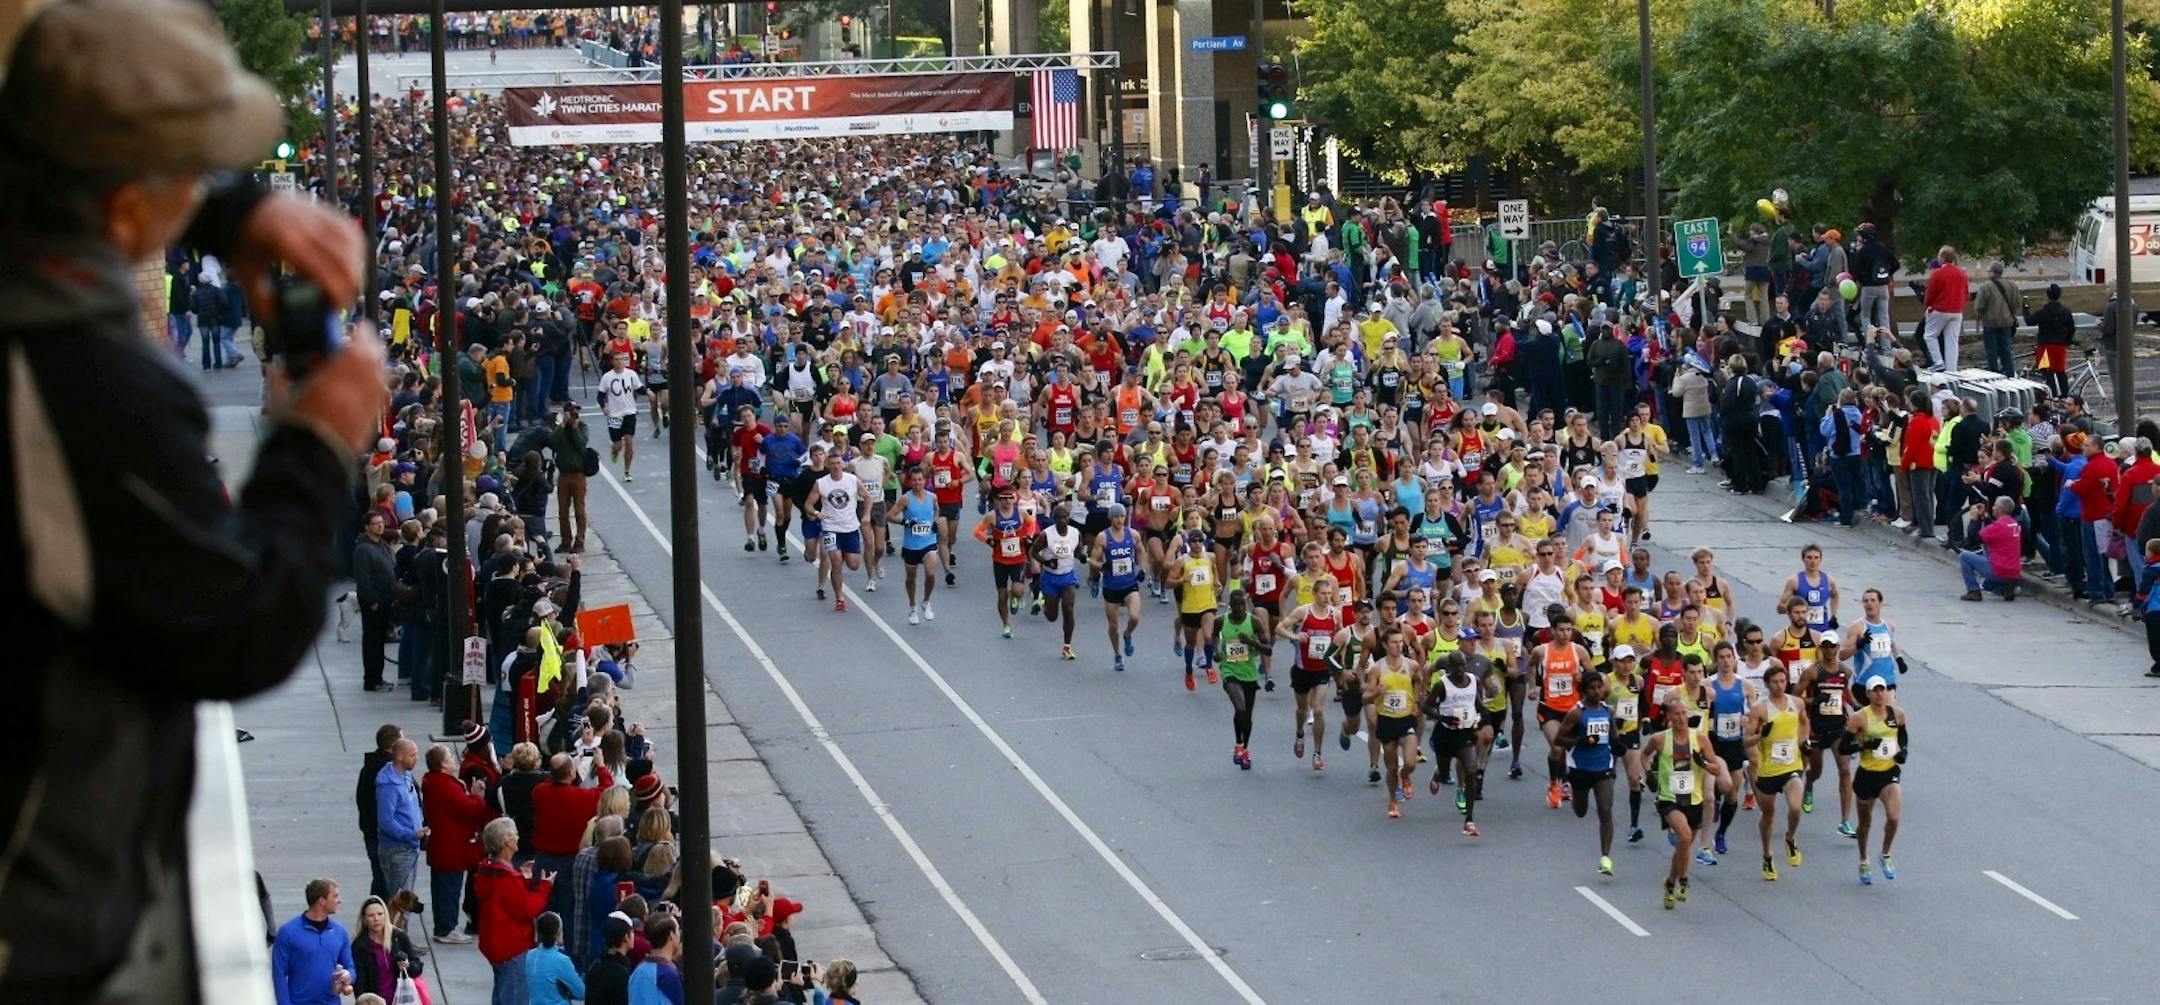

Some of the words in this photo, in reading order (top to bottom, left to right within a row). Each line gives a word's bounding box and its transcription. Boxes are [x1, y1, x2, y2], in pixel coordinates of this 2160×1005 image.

[1192, 39, 1226, 49] Portland
[1232, 39, 1244, 48] Av
[560, 95, 614, 104] MEDTRONIC
[707, 86, 816, 114] START
[560, 104, 586, 114] TWIN
[588, 103, 620, 113] CITIES
[714, 126, 749, 134] Medtronic
[784, 124, 820, 133] Medtronic
[1273, 131, 1289, 139] ONE
[1273, 139, 1290, 147] WAY
[274, 175, 292, 183] ONE
[1503, 203, 1524, 213] ONE
[1503, 214, 1523, 224] WAY
[1684, 222, 1709, 234] EAST
[1691, 242, 1706, 252] 94
[1098, 481, 1117, 489] GRC
[1484, 527, 1498, 537] 211
[1110, 547, 1131, 556] GRC
[1877, 641, 1886, 650] 11
[1389, 697, 1402, 708] 22
[1781, 747, 1788, 757] 5
[1679, 779, 1686, 790] 8
